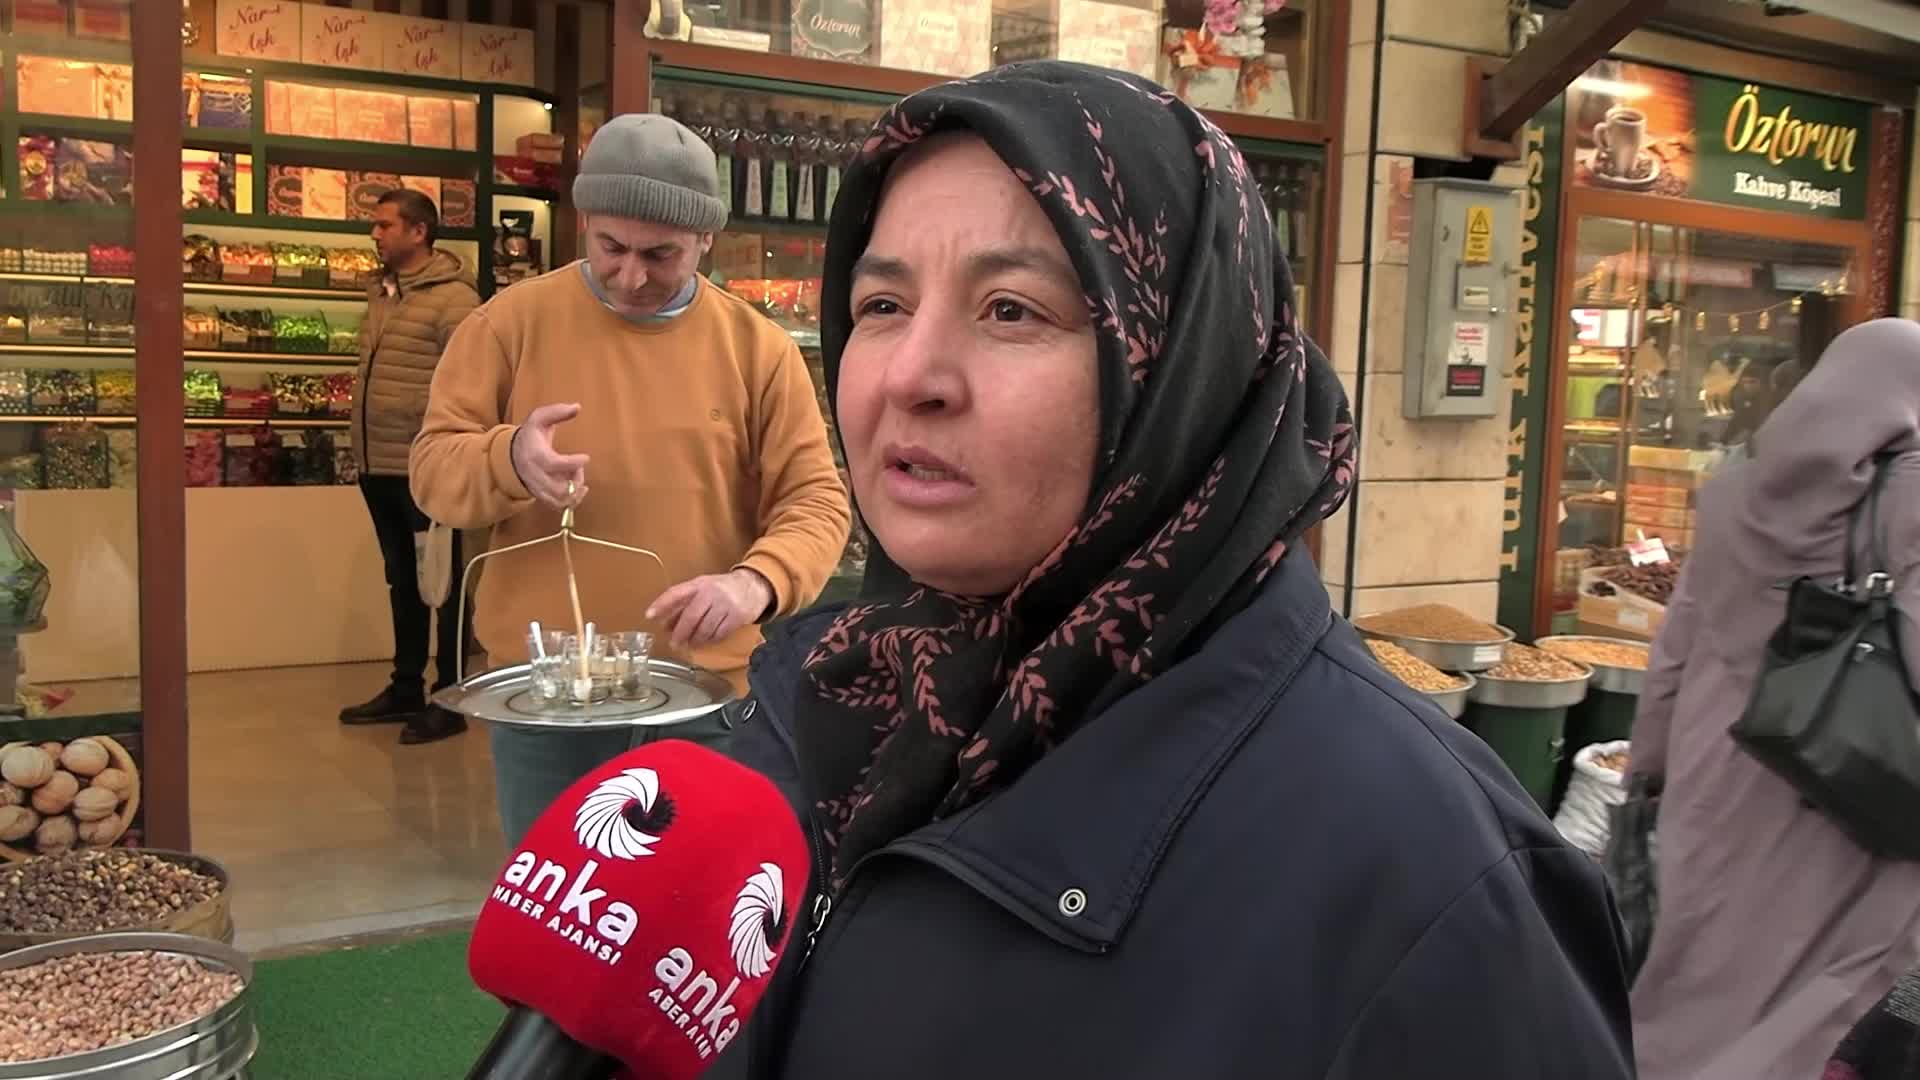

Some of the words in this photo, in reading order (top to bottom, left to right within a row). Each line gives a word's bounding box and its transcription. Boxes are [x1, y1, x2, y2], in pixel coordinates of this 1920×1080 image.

[1725, 84, 1857, 173] Öztorun
[1734, 172, 1787, 200] Kahve
[1788, 180, 1842, 210] Köşesi
[492, 884, 545, 920] HABER
[546, 915, 622, 966] AJANSI
[504, 850, 639, 947] anka
[655, 946, 741, 1054] anka
